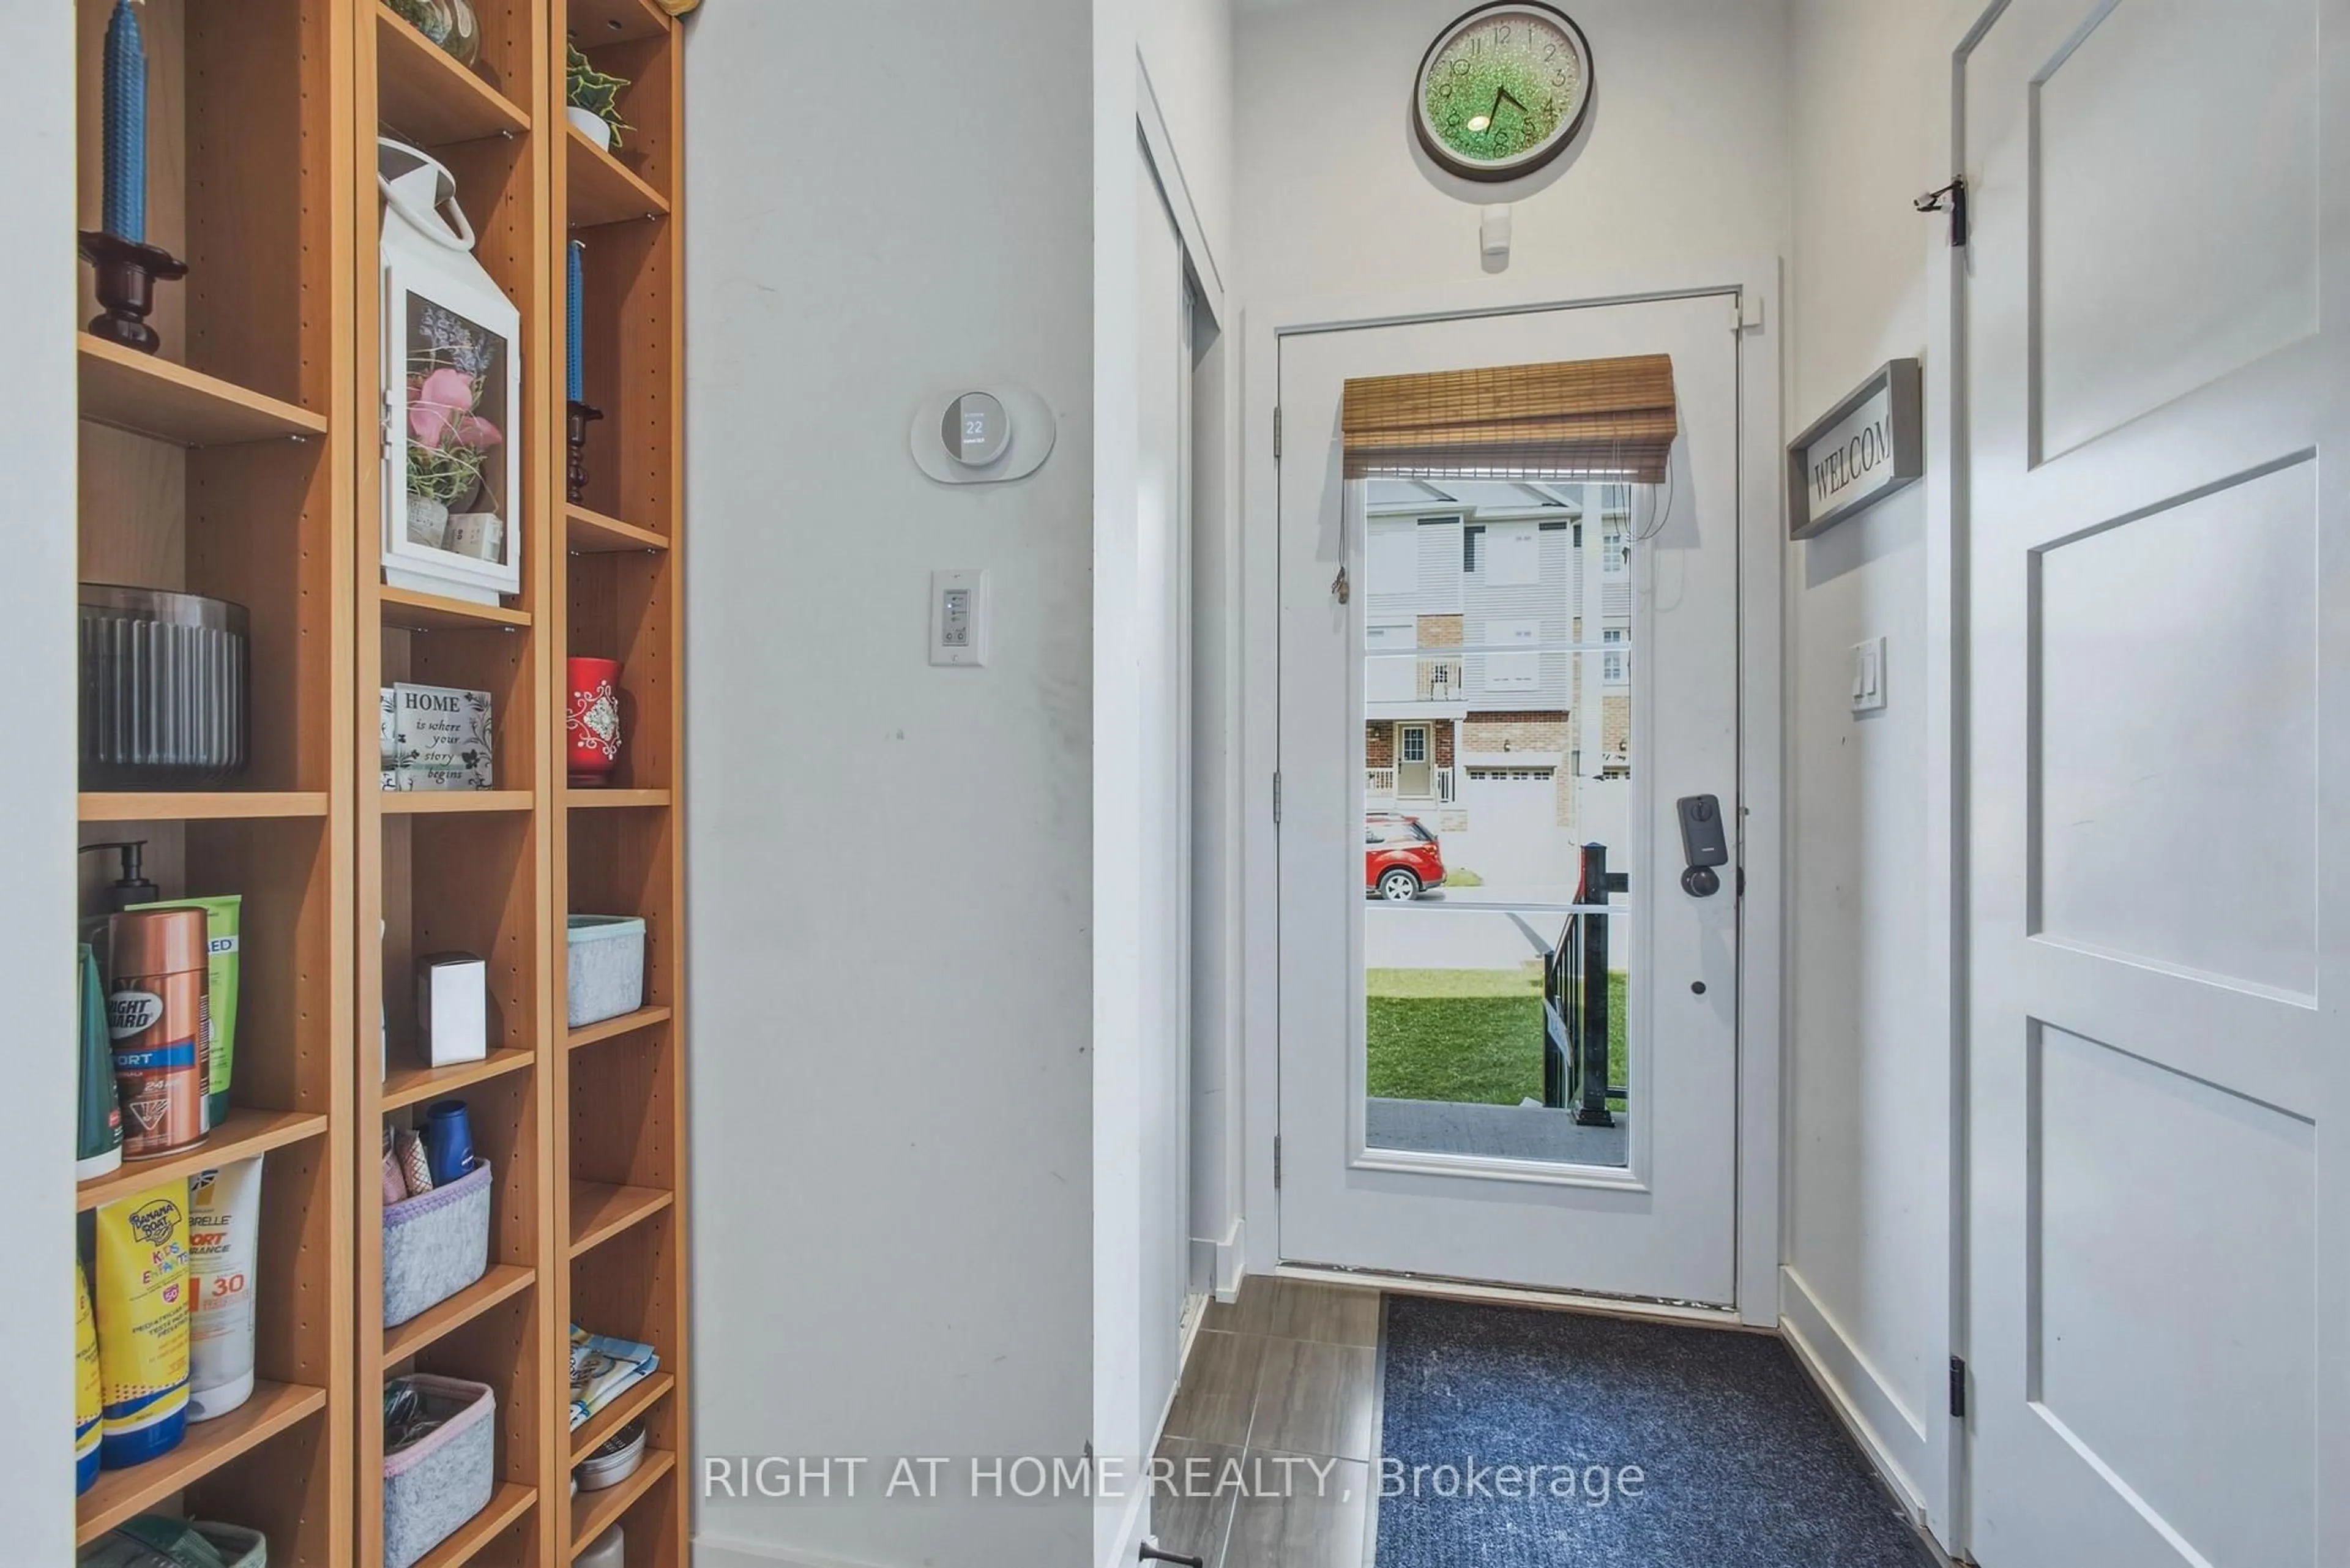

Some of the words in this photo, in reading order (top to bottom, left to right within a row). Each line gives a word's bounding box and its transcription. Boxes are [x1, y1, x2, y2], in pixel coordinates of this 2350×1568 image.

[1494, 25, 1511, 45] 12
[1471, 39, 1481, 56] 11
[1543, 43, 1556, 62] 2
[1449, 58, 1471, 76] 10
[1552, 68, 1566, 87] 3
[966, 420, 983, 434] 22
[1814, 414, 1890, 502] WELCOM
[406, 692, 460, 712] HOME
[416, 718, 427, 730] is
[428, 719, 461, 731] where
[425, 734, 461, 749] your
[424, 751, 455, 767] story
[428, 767, 463, 785] begins
[207, 939, 233, 952] ED
[118, 1053, 153, 1066] ORT
[129, 1204, 174, 1229] BANANA
[188, 1215, 232, 1226] BRELLE
[143, 1216, 168, 1238] BOAT
[189, 1232, 228, 1246] ORT
[152, 1242, 180, 1264] KIDS
[189, 1244, 232, 1254] RANCE
[212, 1274, 244, 1297] 30
